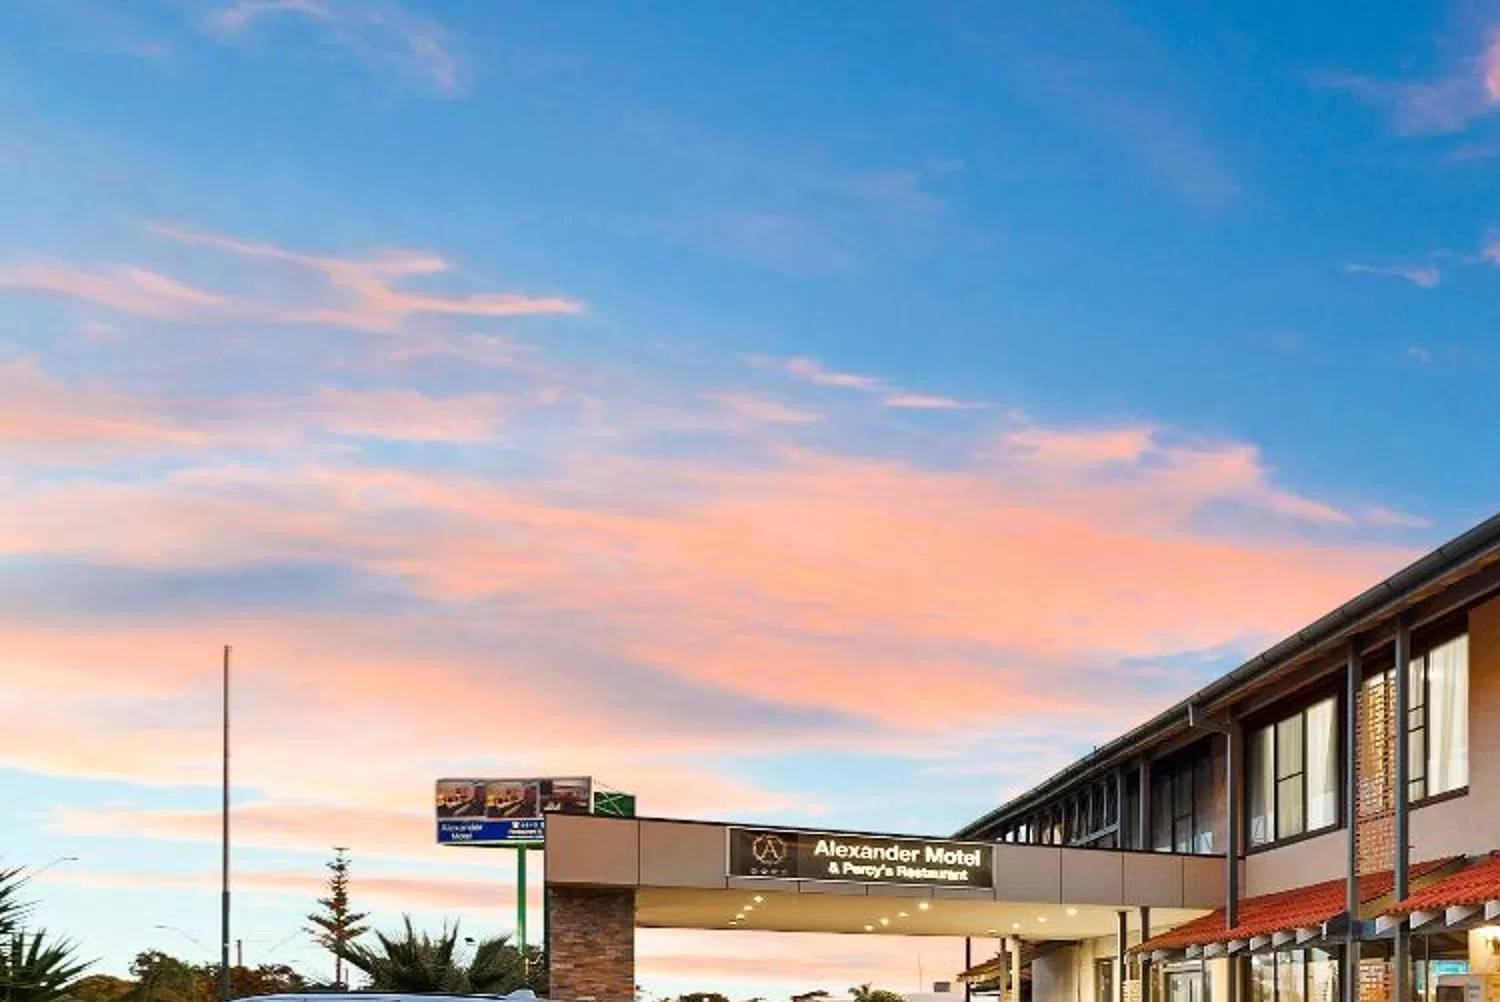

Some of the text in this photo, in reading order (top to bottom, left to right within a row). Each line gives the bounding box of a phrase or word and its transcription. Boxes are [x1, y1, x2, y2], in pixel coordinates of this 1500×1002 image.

[813, 839, 982, 867] Alexander Motel
[828, 861, 969, 881] & Percy's Restaurant
